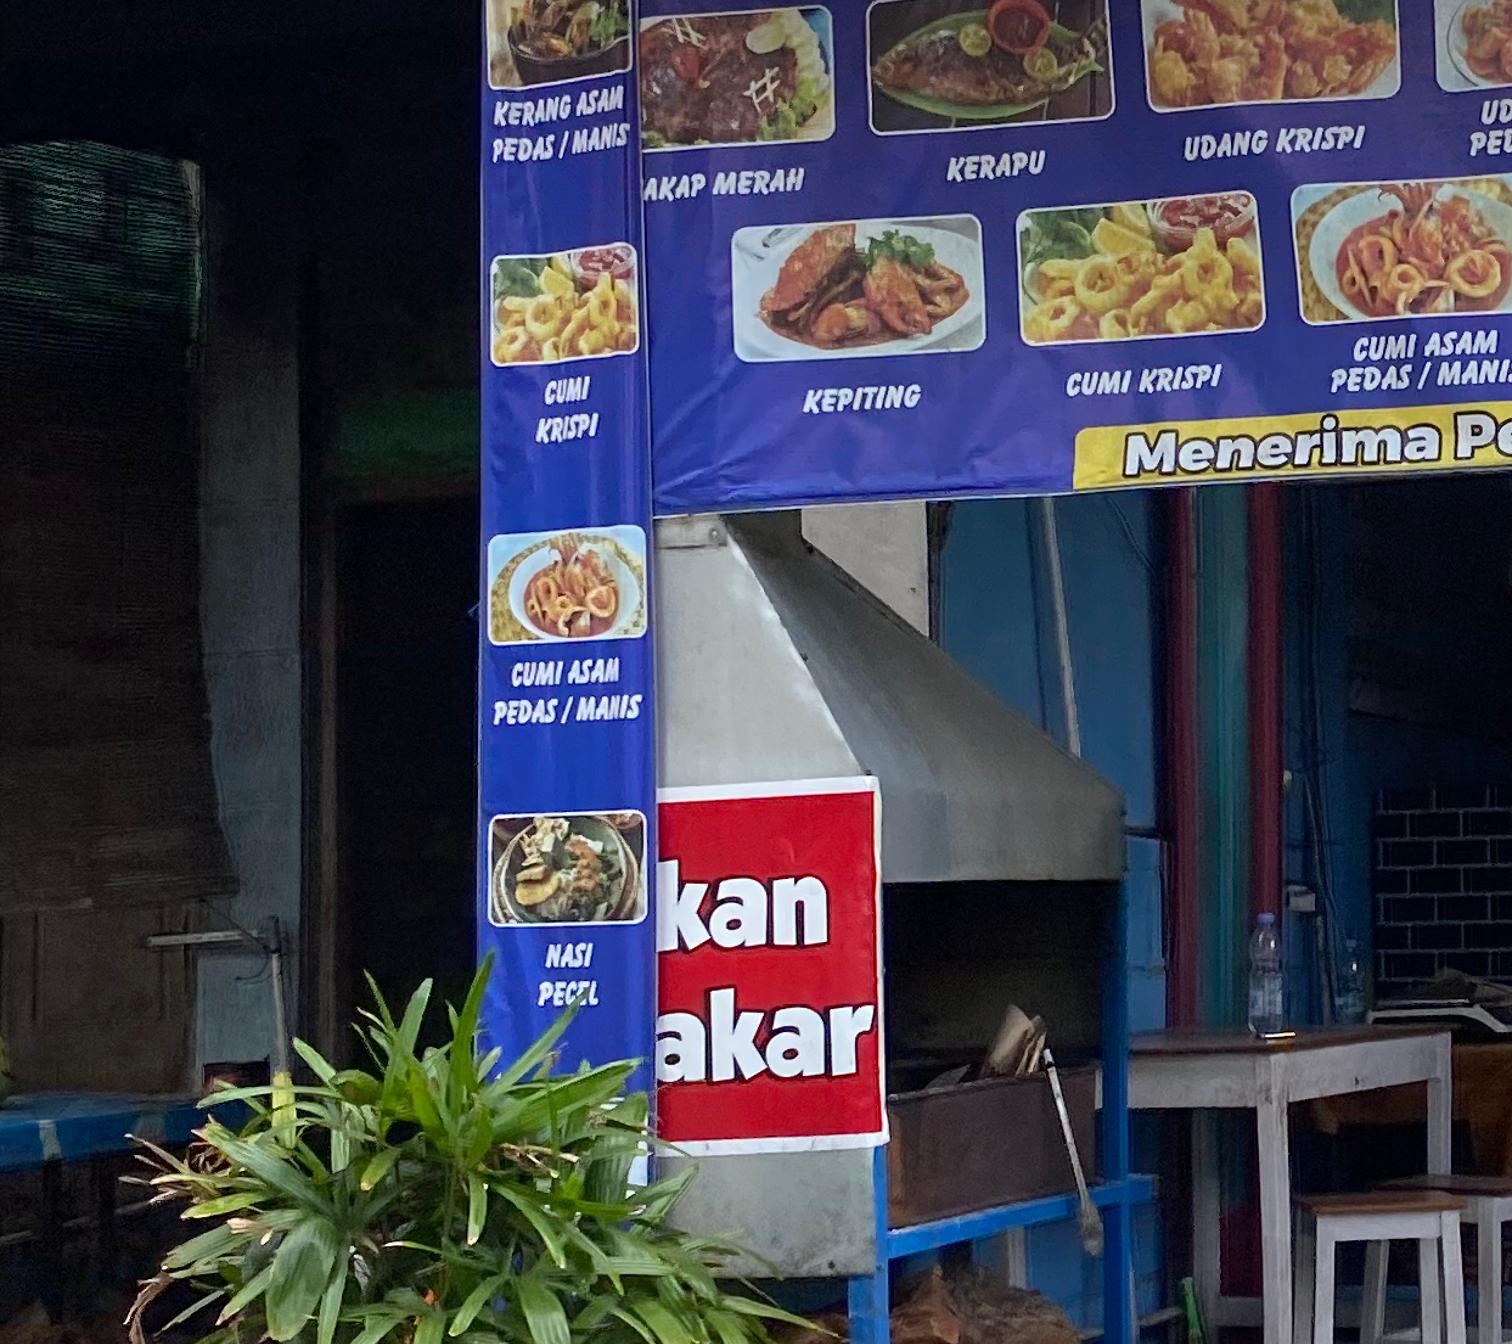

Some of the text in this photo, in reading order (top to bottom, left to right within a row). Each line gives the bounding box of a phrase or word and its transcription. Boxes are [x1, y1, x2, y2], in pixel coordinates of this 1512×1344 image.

[494, 85, 624, 126] KERANG ASAM
[492, 135, 555, 164] PEDAS
[572, 122, 630, 155] MANIS
[1183, 125, 1365, 160] UDANG KRISPI
[947, 150, 1046, 183] KERAPU
[643, 167, 805, 202] AKAP MERAH
[1353, 329, 1498, 362] CUMI ASAM
[544, 376, 591, 406] CUMI
[1066, 364, 1222, 397] CUMI KRISPI
[1330, 365, 1412, 393] PEDAS
[803, 384, 922, 415] KEPITING
[535, 413, 600, 445] KRISPI
[1122, 415, 1442, 476] Menerima
[511, 657, 619, 689] CUMI ASAM
[493, 699, 557, 726] PEDAS
[577, 694, 642, 722] MANIS
[655, 859, 829, 952] kan
[545, 942, 594, 969] NASI
[537, 980, 599, 1007] PECEL
[656, 987, 875, 1083] akar
